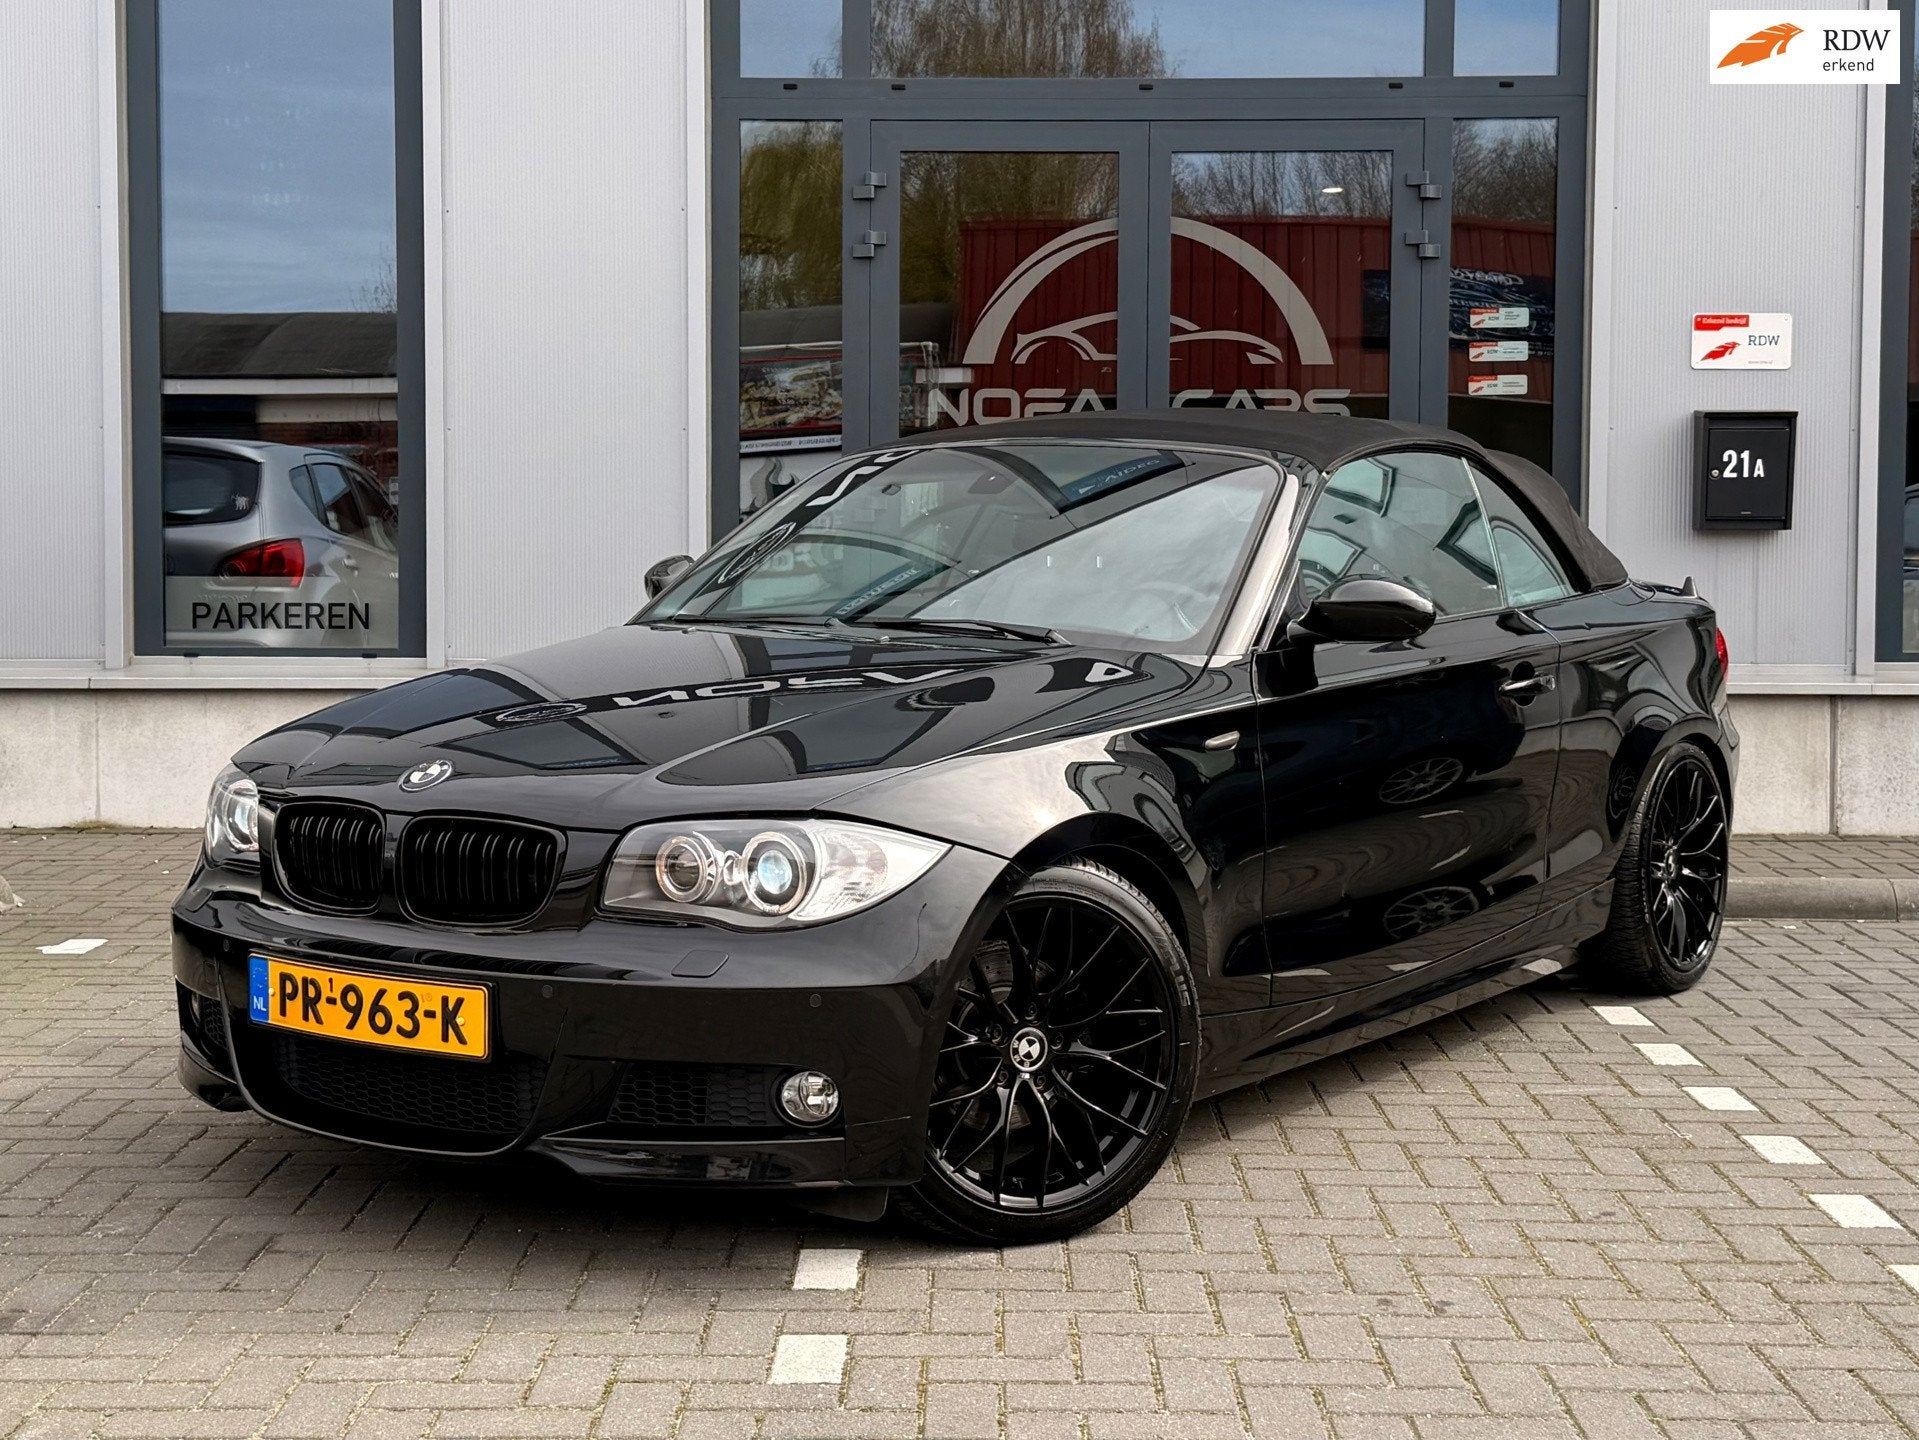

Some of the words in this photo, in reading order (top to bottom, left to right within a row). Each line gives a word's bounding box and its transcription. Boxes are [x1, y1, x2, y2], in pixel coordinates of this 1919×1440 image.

[1748, 335, 1780, 346] RDW
[1722, 449, 1765, 478] 21A
[192, 602, 370, 630] PARKEREN
[252, 995, 267, 1012] NL
[279, 971, 468, 1046] PR-963-K
